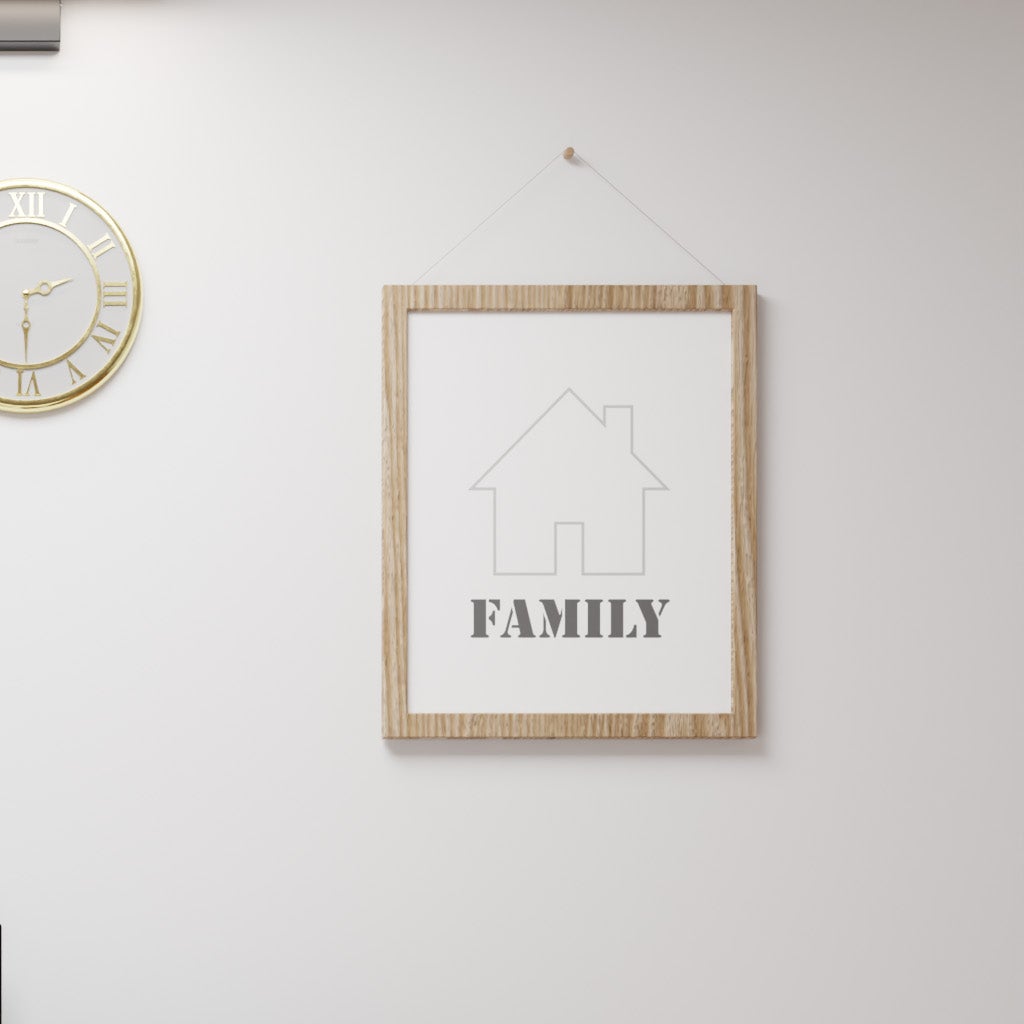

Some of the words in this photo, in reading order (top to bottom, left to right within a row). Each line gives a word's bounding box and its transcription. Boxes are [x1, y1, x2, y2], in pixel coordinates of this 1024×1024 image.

[8, 191, 46, 218] XII
[59, 203, 78, 228] I
[87, 233, 116, 260] II
[103, 281, 128, 308] III
[91, 322, 121, 354] IV
[15, 368, 42, 396] VI
[66, 359, 87, 385] V
[470, 598, 670, 638] FAMILY
